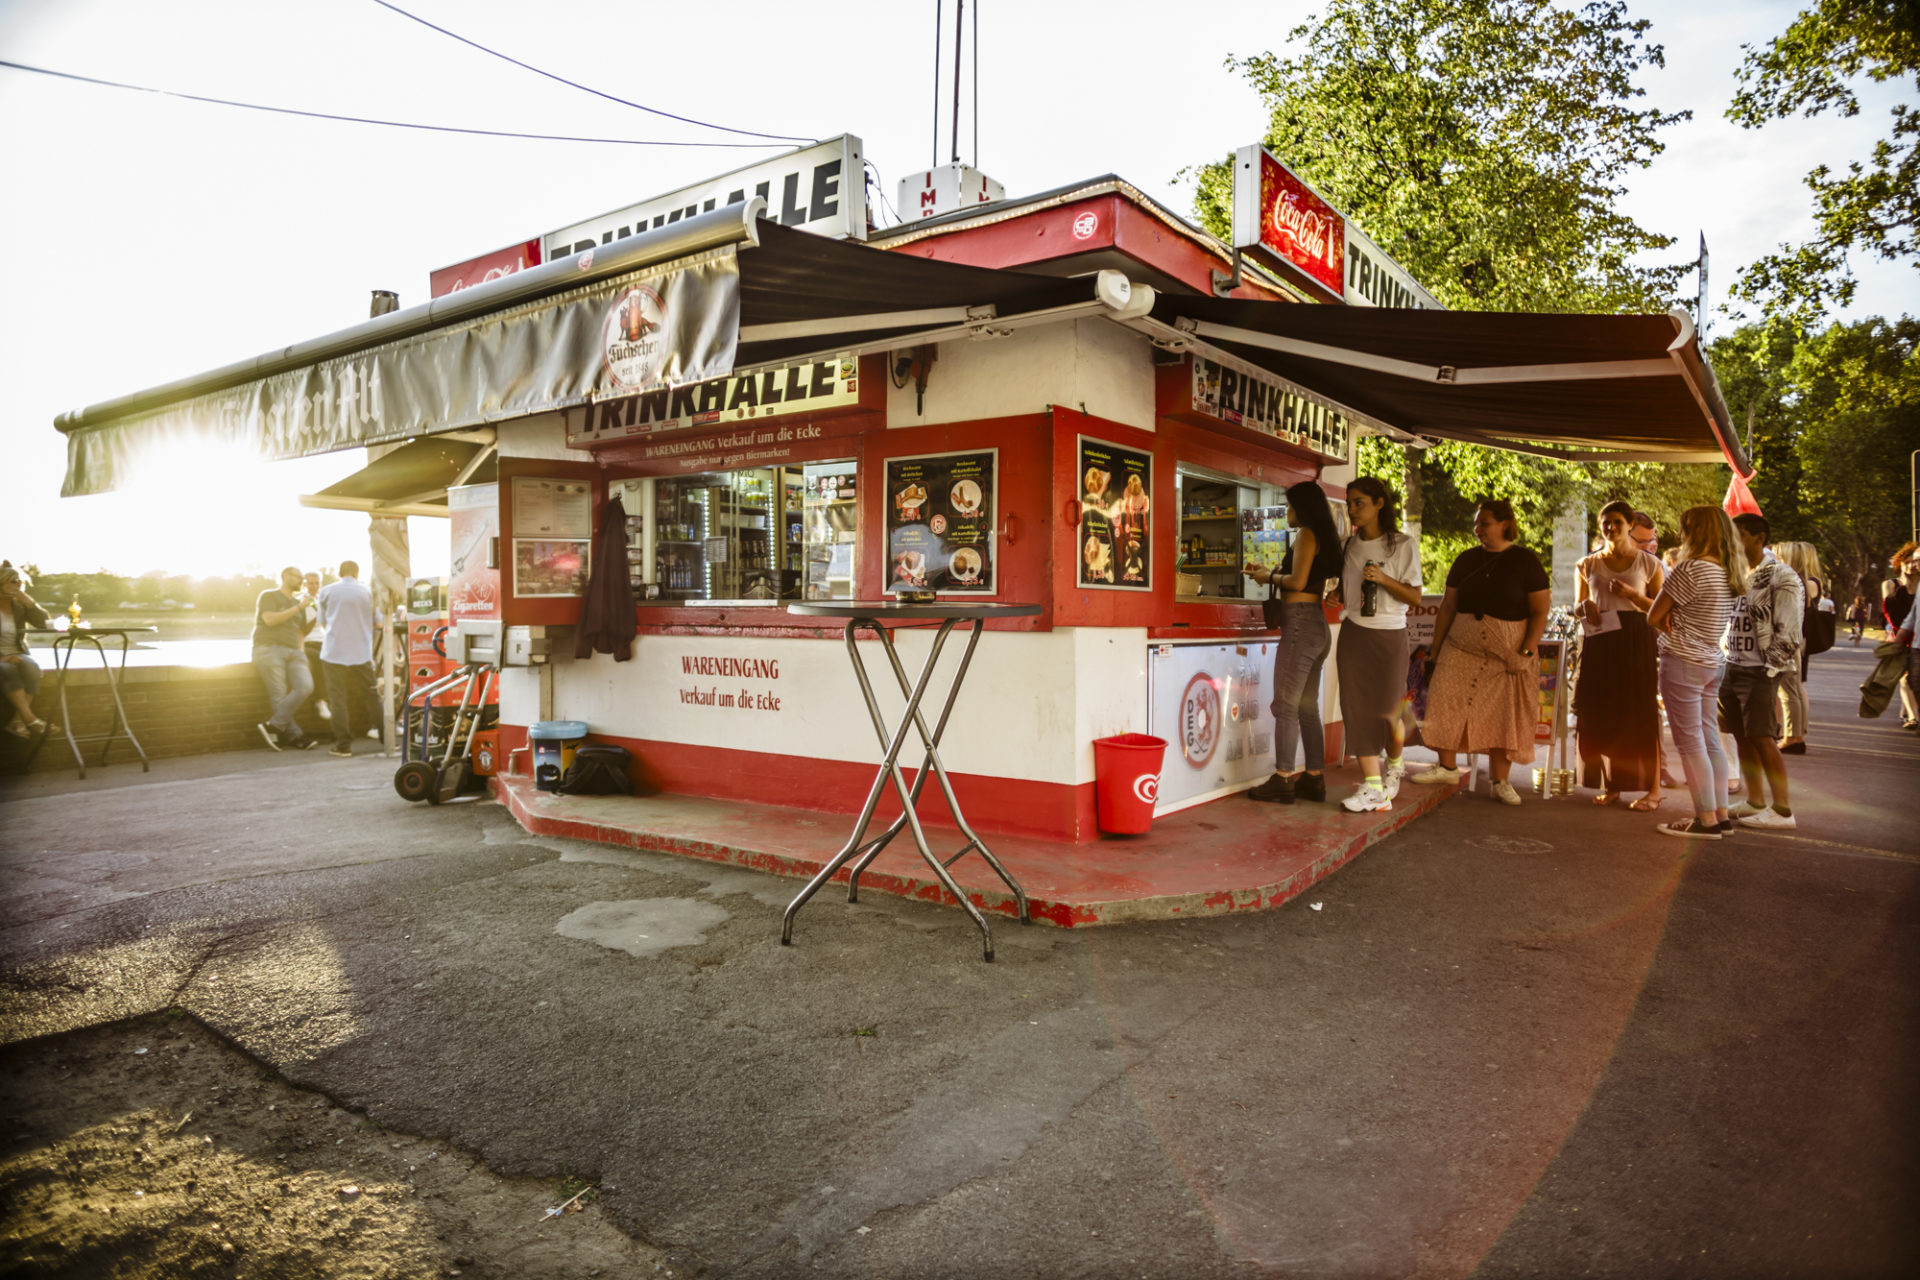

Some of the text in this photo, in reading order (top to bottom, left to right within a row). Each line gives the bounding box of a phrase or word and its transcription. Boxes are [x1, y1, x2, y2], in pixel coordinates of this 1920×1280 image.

[645, 424, 821, 457] WARENEINGANG Verkauf um die Ecke
[709, 456, 722, 465] nur
[453, 601, 494, 613] Zigaretten
[681, 655, 779, 679] WARENEINGANG
[679, 685, 781, 711] Verkauf um die Ecke
[1186, 699, 1194, 747] DEG
